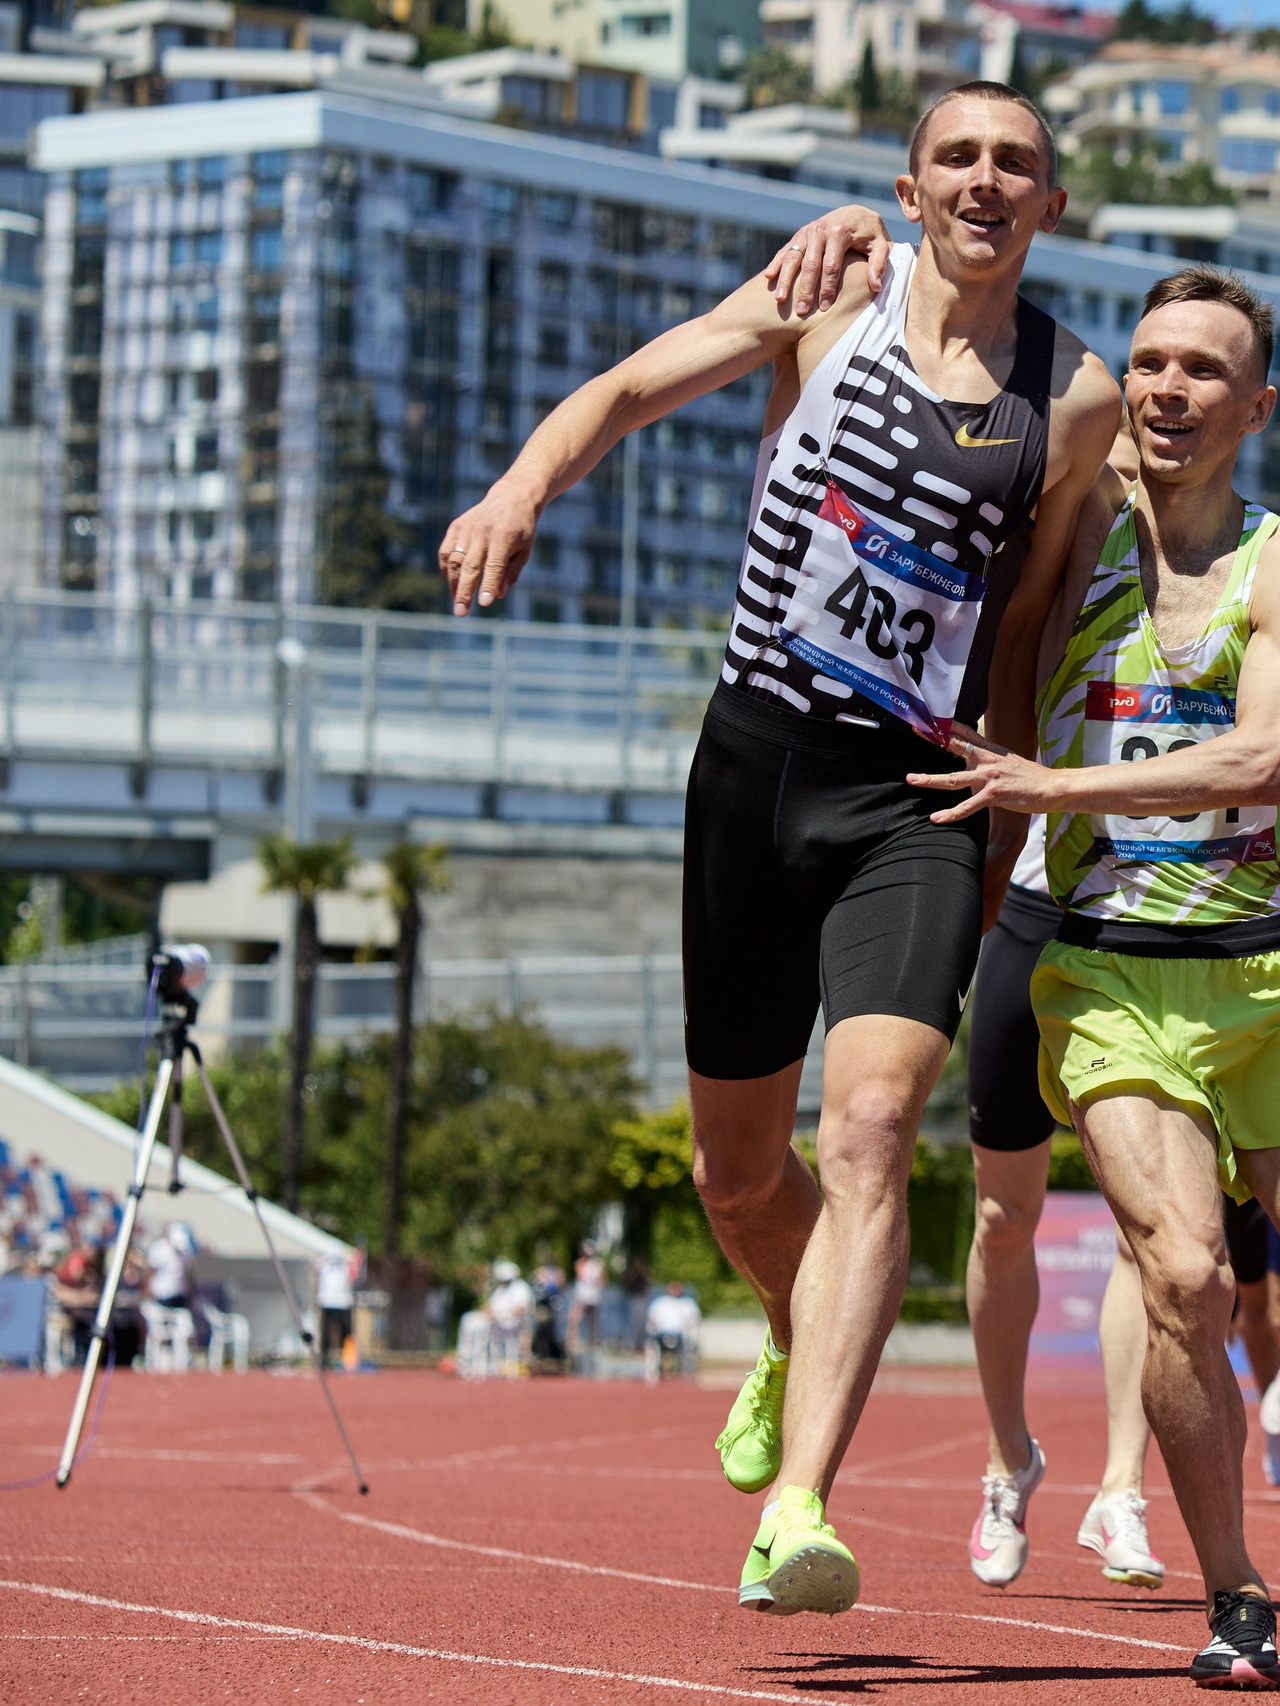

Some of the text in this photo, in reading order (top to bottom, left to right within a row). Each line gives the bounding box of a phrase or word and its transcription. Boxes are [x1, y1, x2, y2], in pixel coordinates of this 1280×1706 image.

[824, 565, 936, 687] 403
[788, 643, 824, 669] СОЧИ 2024
[791, 637, 910, 711] КОМАНДНЫЙ ЧЕМПИОНАТ РОССИИ
[1146, 845, 1195, 856] ЧЕМПИОНАТ
